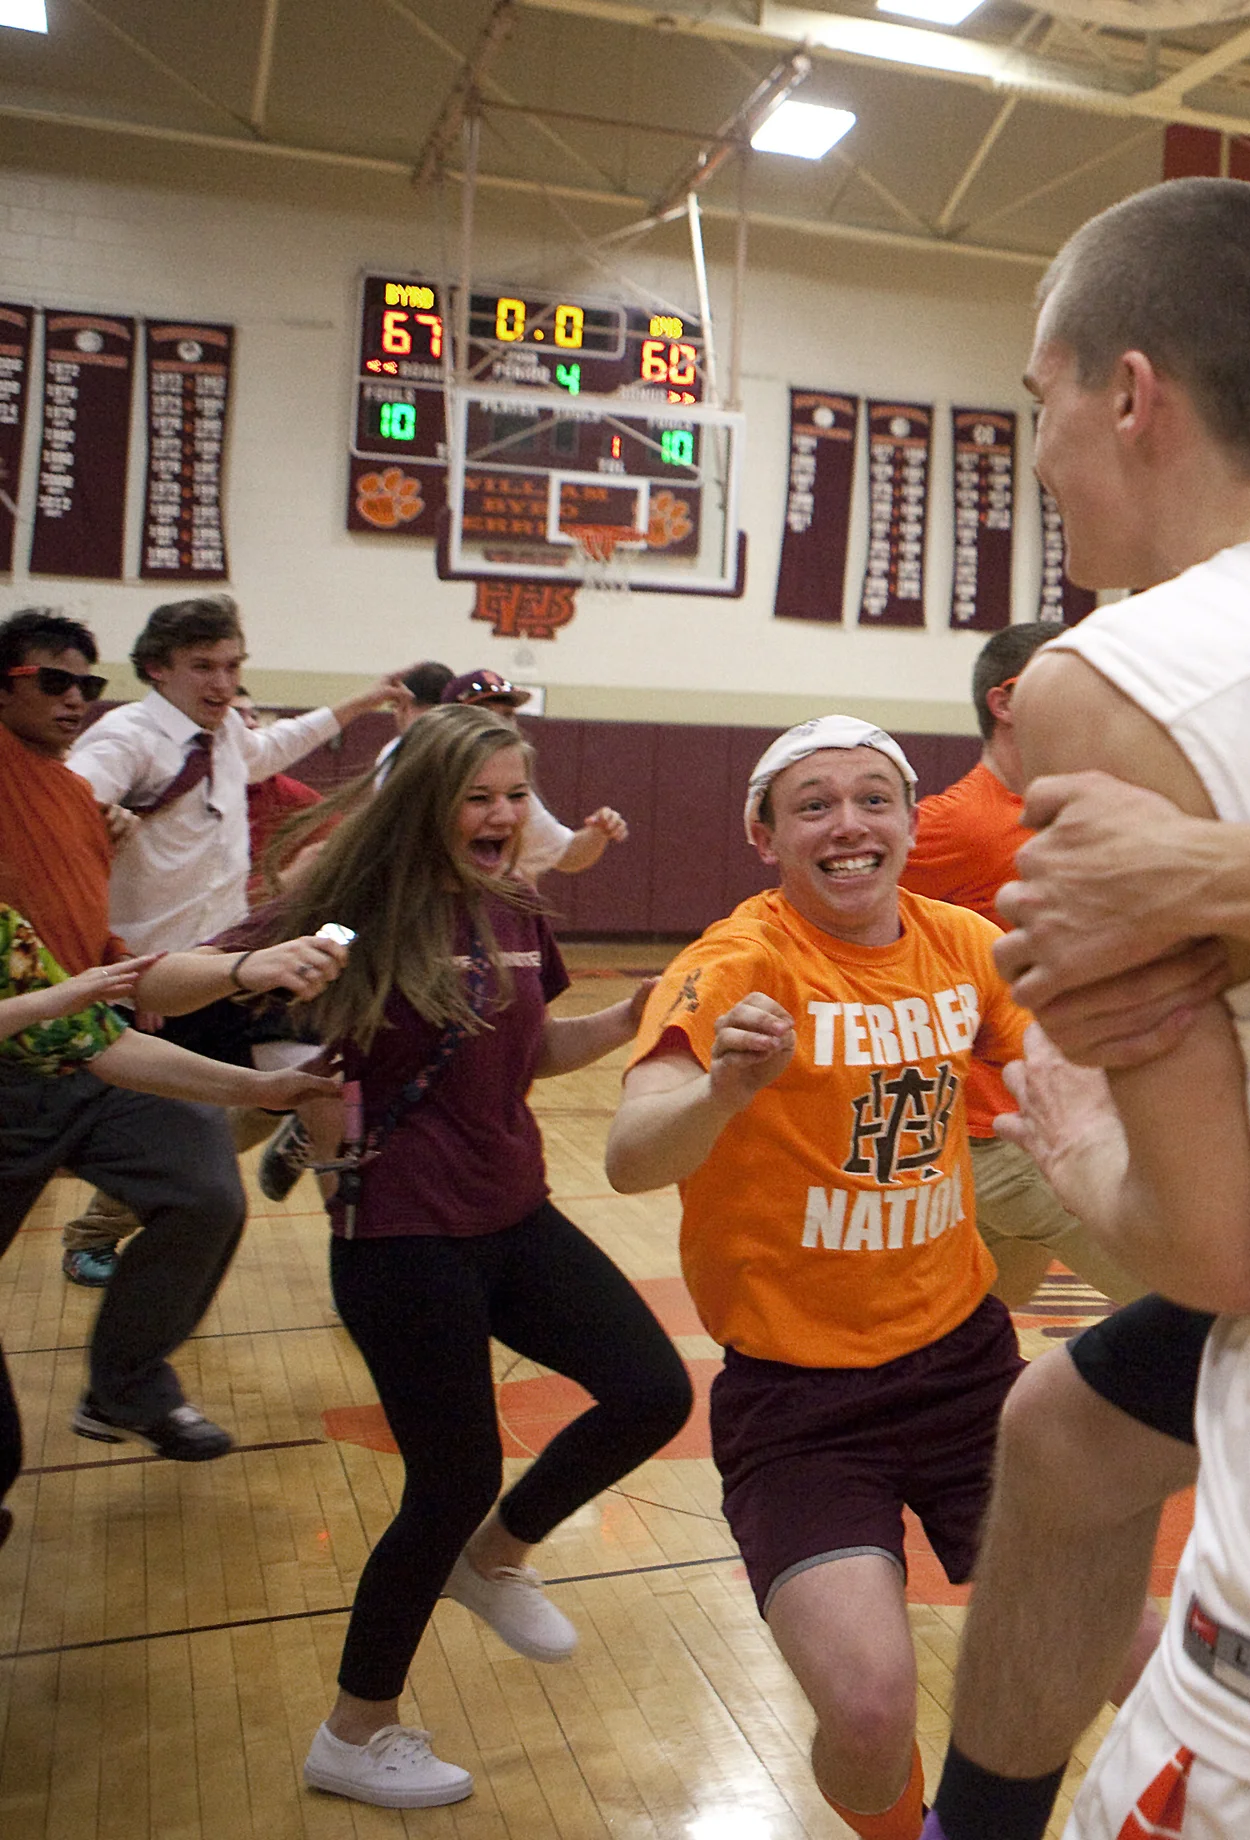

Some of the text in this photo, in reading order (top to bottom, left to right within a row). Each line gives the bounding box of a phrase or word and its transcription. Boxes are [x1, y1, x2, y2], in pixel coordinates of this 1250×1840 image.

[382, 310, 443, 358] 67
[496, 297, 584, 349] 0.0
[400, 361, 448, 381] BONU
[556, 363, 581, 396] 4
[641, 339, 697, 386] 60
[380, 402, 416, 441] 10
[612, 435, 622, 459] 1
[661, 430, 694, 466] 10
[1235, 1646, 1248, 1667] L
